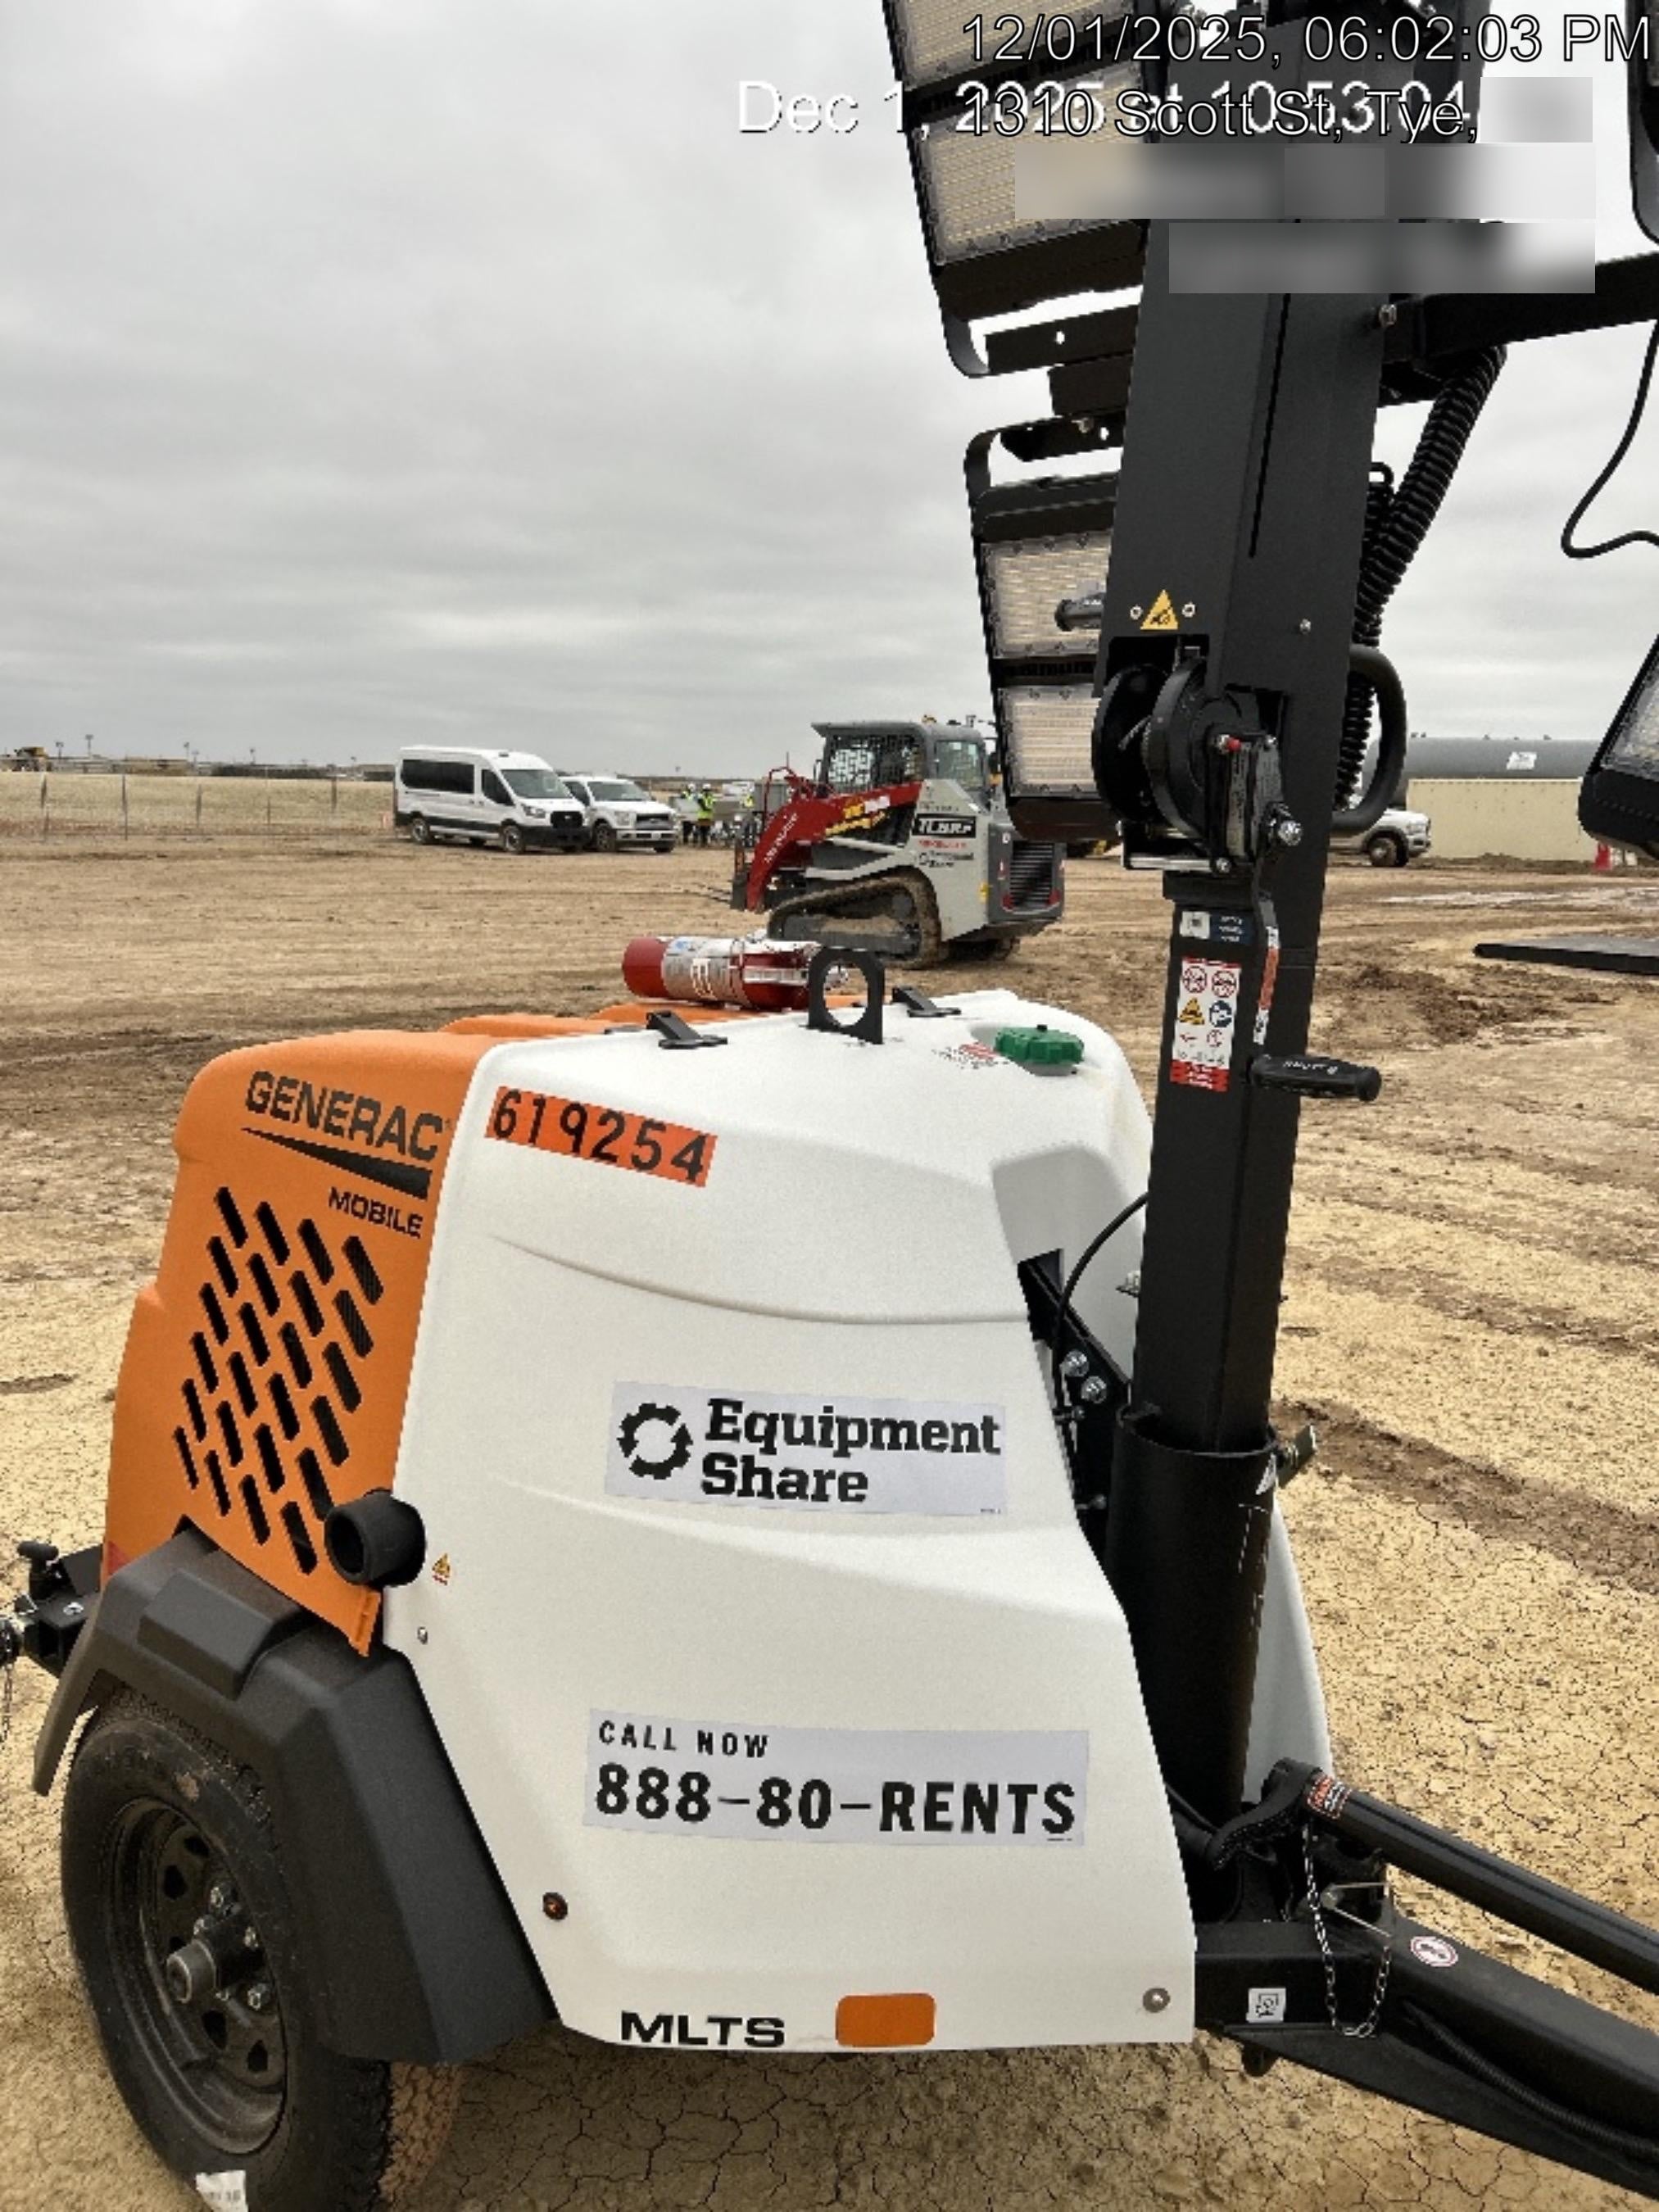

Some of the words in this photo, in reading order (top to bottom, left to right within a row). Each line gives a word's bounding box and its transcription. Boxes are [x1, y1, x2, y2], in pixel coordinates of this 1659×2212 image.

[245, 1071, 443, 1162] GENERAC
[493, 1088, 709, 1183] 619254
[329, 1186, 424, 1240] MOBILE
[705, 1397, 1002, 1459] Equipment
[700, 1452, 869, 1503] Share
[598, 1720, 678, 1752] CALL
[696, 1729, 769, 1758] NOW
[595, 1762, 1076, 1835] 888-80-RENTS
[620, 2010, 786, 2048] MLTS
